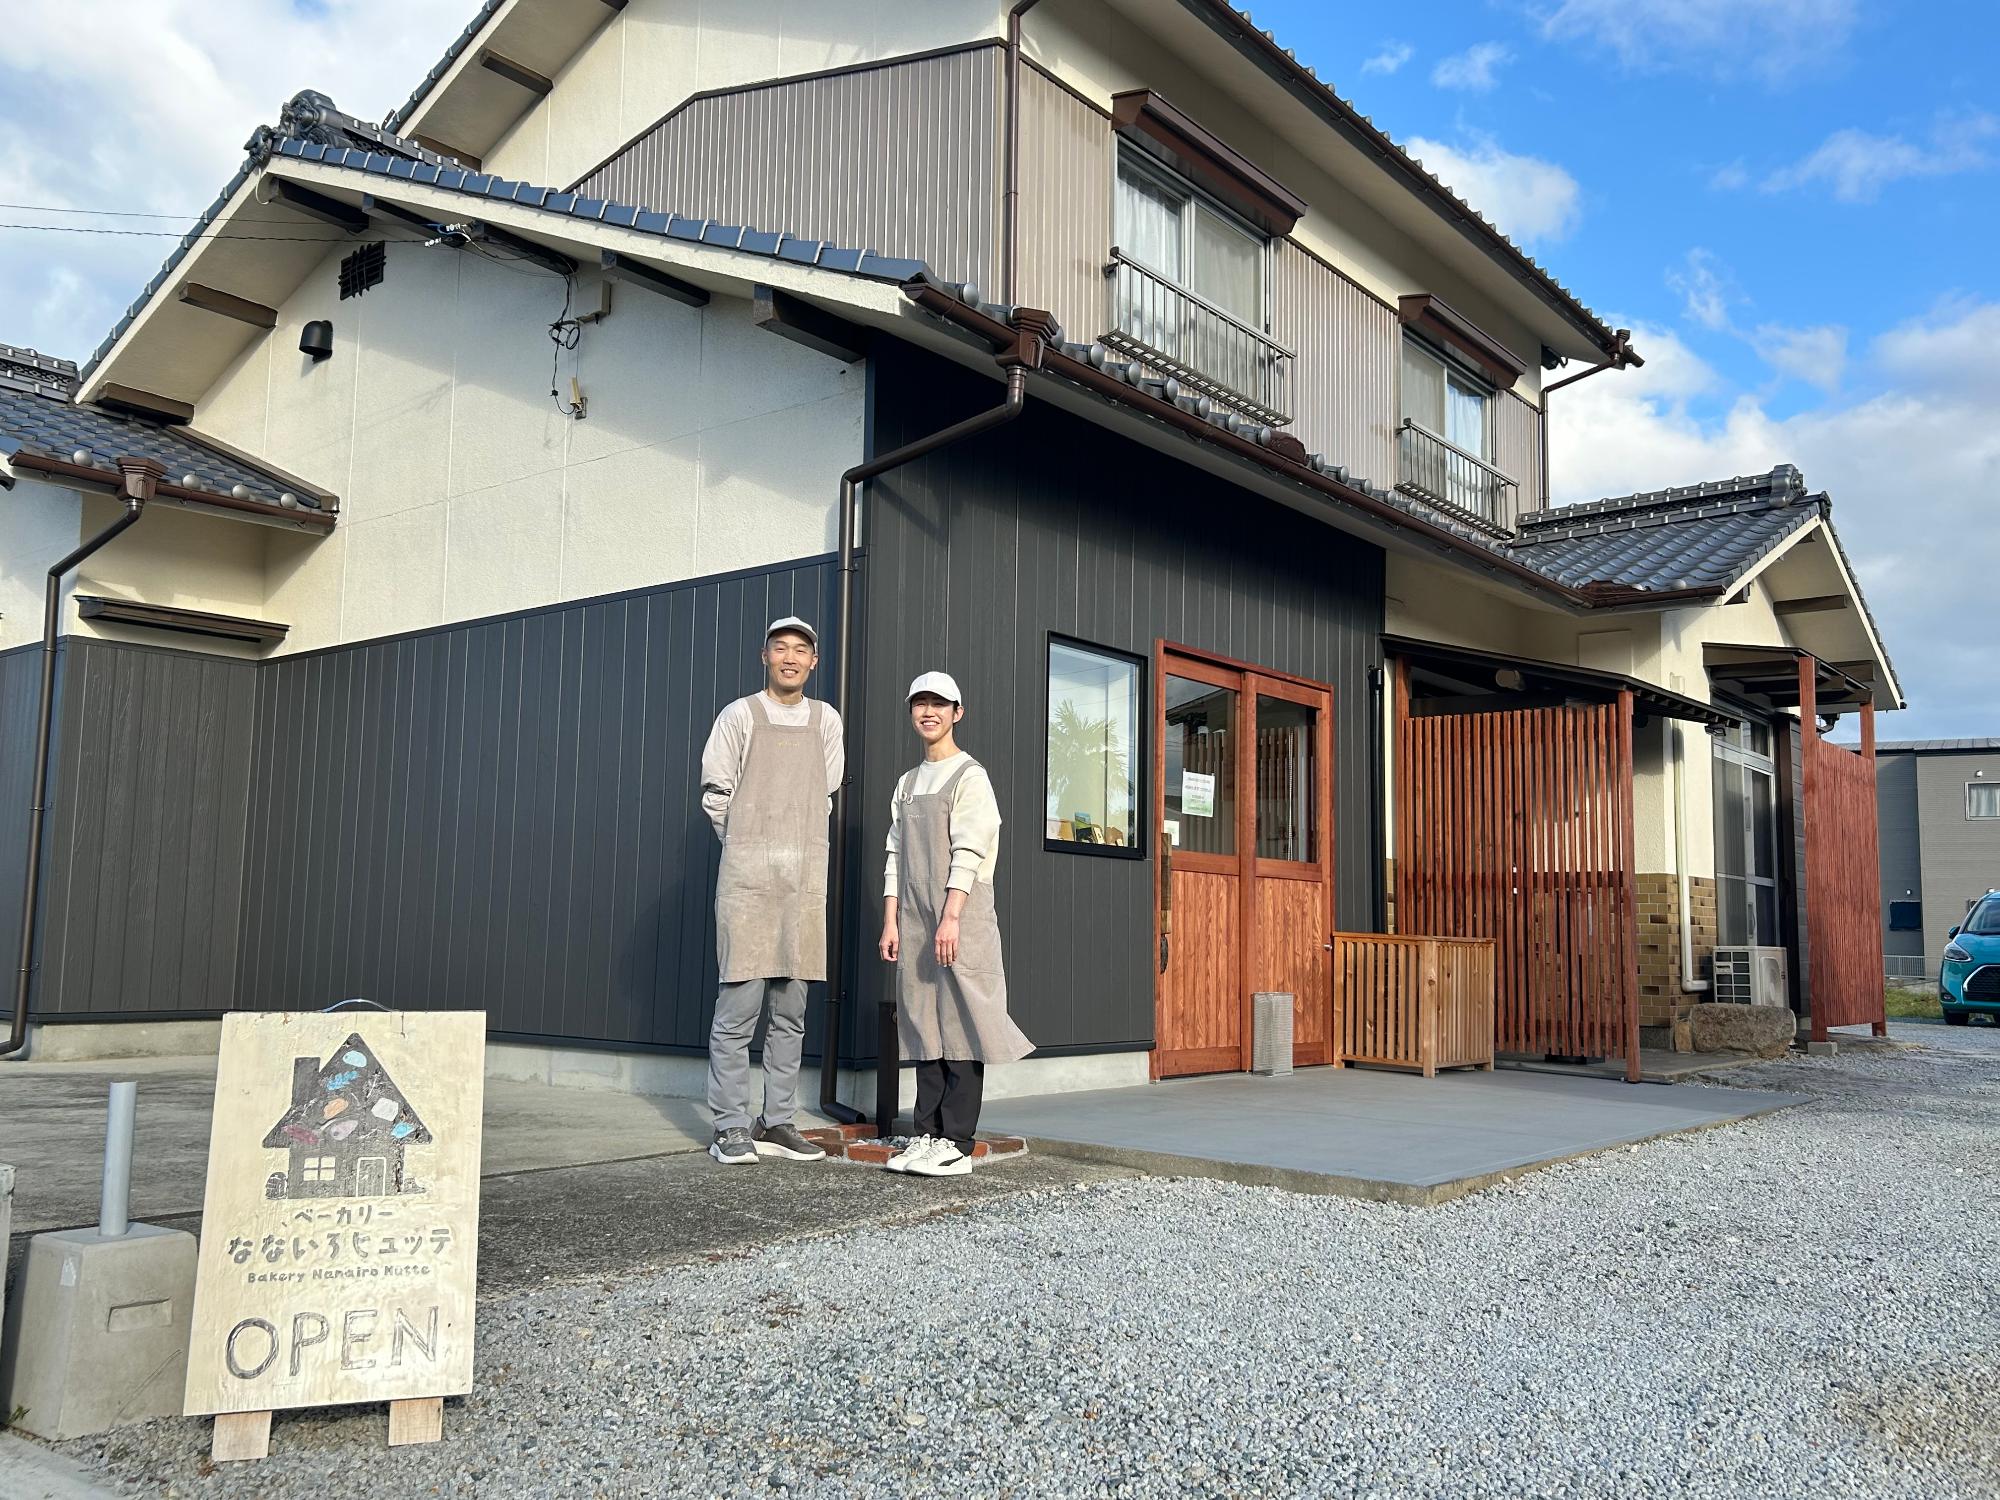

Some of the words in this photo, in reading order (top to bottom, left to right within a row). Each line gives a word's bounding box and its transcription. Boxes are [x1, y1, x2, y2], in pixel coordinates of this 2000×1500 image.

[294, 1204, 393, 1225] ベーカリー
[228, 1228, 451, 1264] なないろヒュッテ
[247, 1271, 305, 1284] Bakery
[225, 1306, 439, 1380] OPEN
